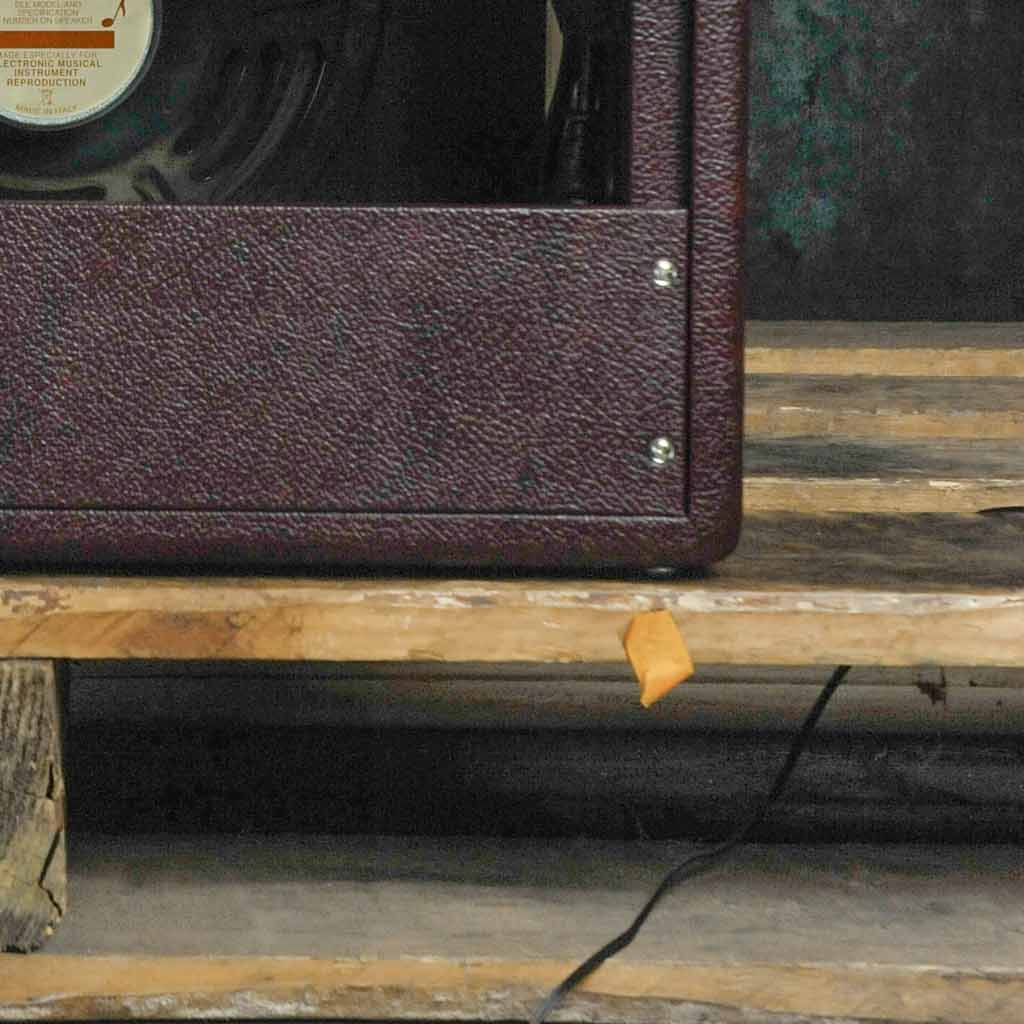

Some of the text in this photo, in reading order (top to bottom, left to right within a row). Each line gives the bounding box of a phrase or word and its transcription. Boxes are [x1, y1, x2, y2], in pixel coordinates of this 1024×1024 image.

[57, 59, 102, 68] MUSICAL
[14, 69, 78, 77] INSTRUMENT
[6, 78, 86, 87] REPRODUCTION
